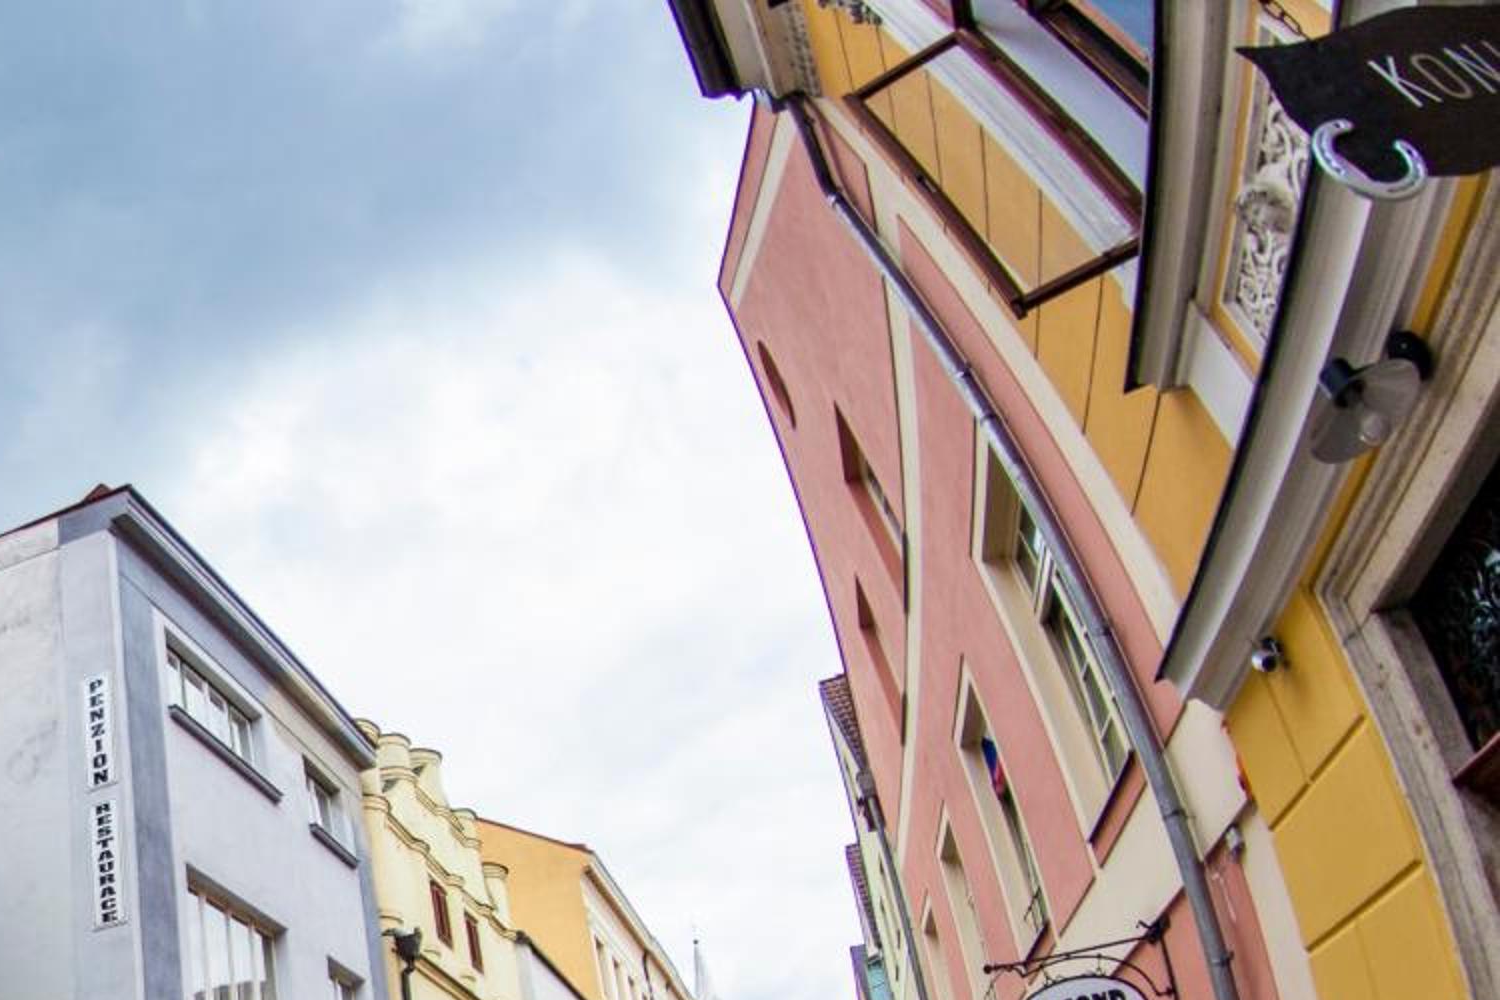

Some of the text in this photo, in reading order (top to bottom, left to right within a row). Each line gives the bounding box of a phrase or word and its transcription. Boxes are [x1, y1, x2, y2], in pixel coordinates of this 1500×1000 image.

[1367, 40, 1500, 107] KON
[90, 679, 117, 923] PENZION RESTAURACE
